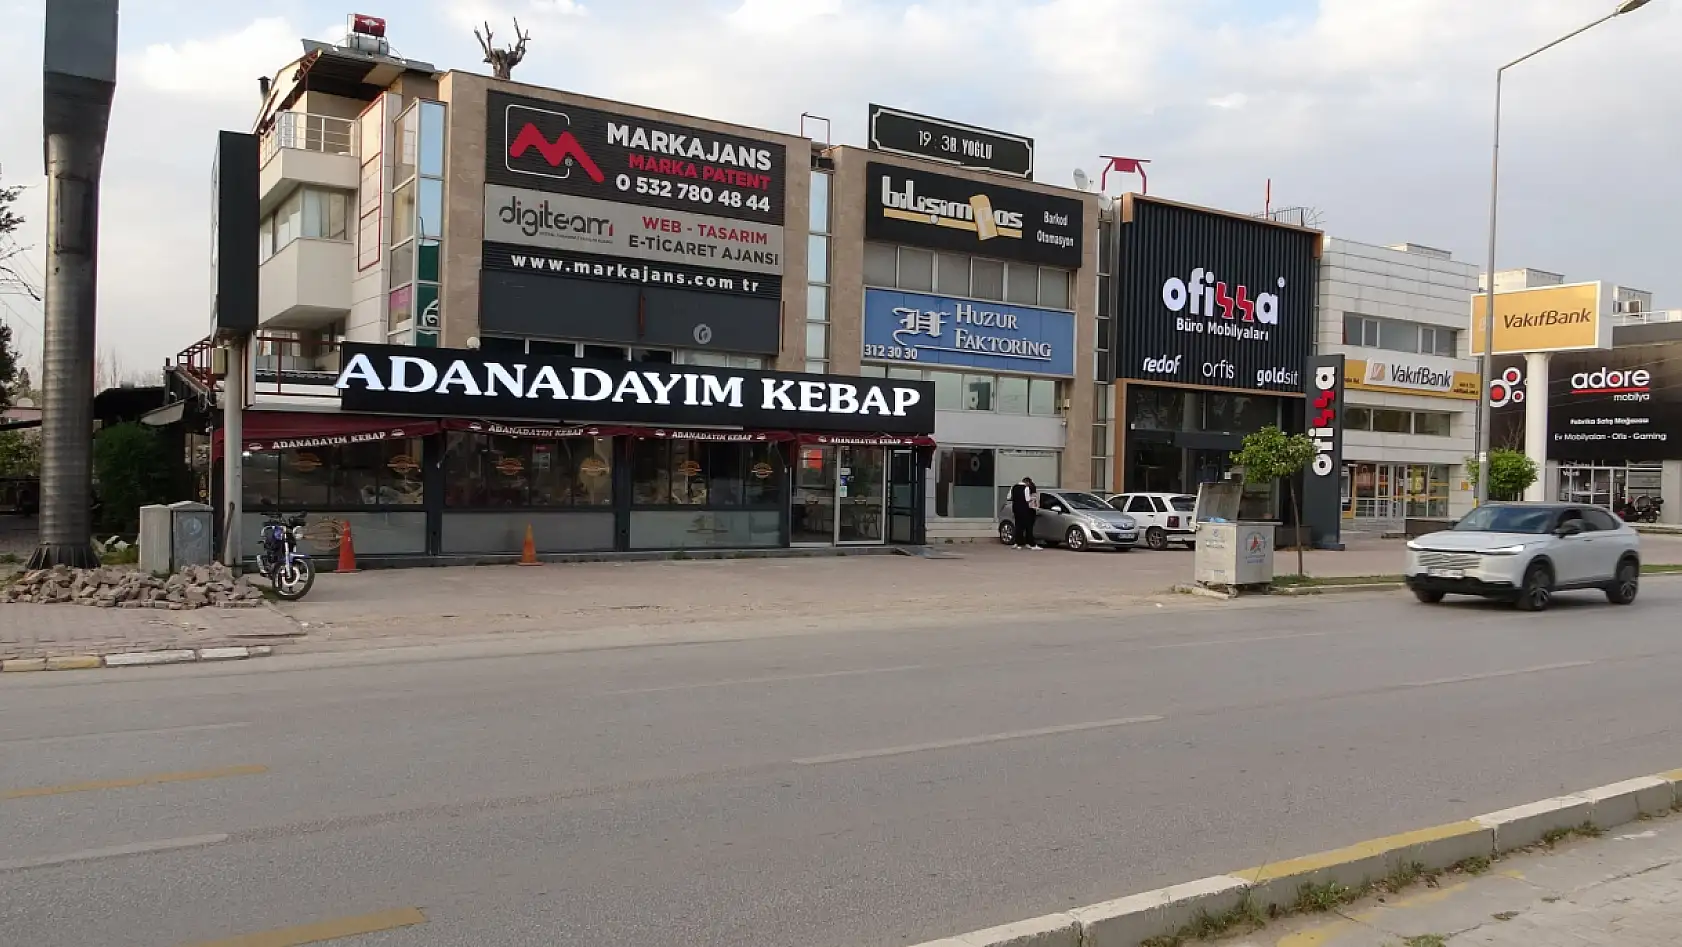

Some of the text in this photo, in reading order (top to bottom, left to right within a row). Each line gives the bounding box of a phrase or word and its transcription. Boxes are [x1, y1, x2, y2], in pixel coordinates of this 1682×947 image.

[607, 122, 772, 171] MARKAJANS
[628, 152, 772, 191] MARKA PATENT
[615, 173, 770, 212] 0 532 780 48 44
[499, 195, 614, 237] digiteam
[1043, 210, 1068, 227] Barkod
[642, 216, 681, 234] WEB
[697, 223, 768, 245] TASARIM
[1036, 229, 1074, 248] Otomasyon
[629, 234, 717, 258] E-TİCARET
[721, 246, 779, 266] AJANSI
[954, 303, 1018, 330] HUZUR
[1503, 307, 1592, 330] VakıfBank
[954, 328, 1052, 357] FAKTORİNG
[1176, 317, 1269, 343] Büro Mobilyaları
[865, 344, 918, 359] 312 30 30
[1142, 354, 1182, 375] redof
[1202, 359, 1234, 380] orfis
[1257, 366, 1299, 387] goldsit
[1391, 363, 1451, 388] VakıfBank
[335, 352, 921, 417] ADANADAYIM KEBAP
[1571, 366, 1650, 389] adore
[1613, 391, 1650, 402] mobilya
[1633, 432, 1667, 441] Gaming
